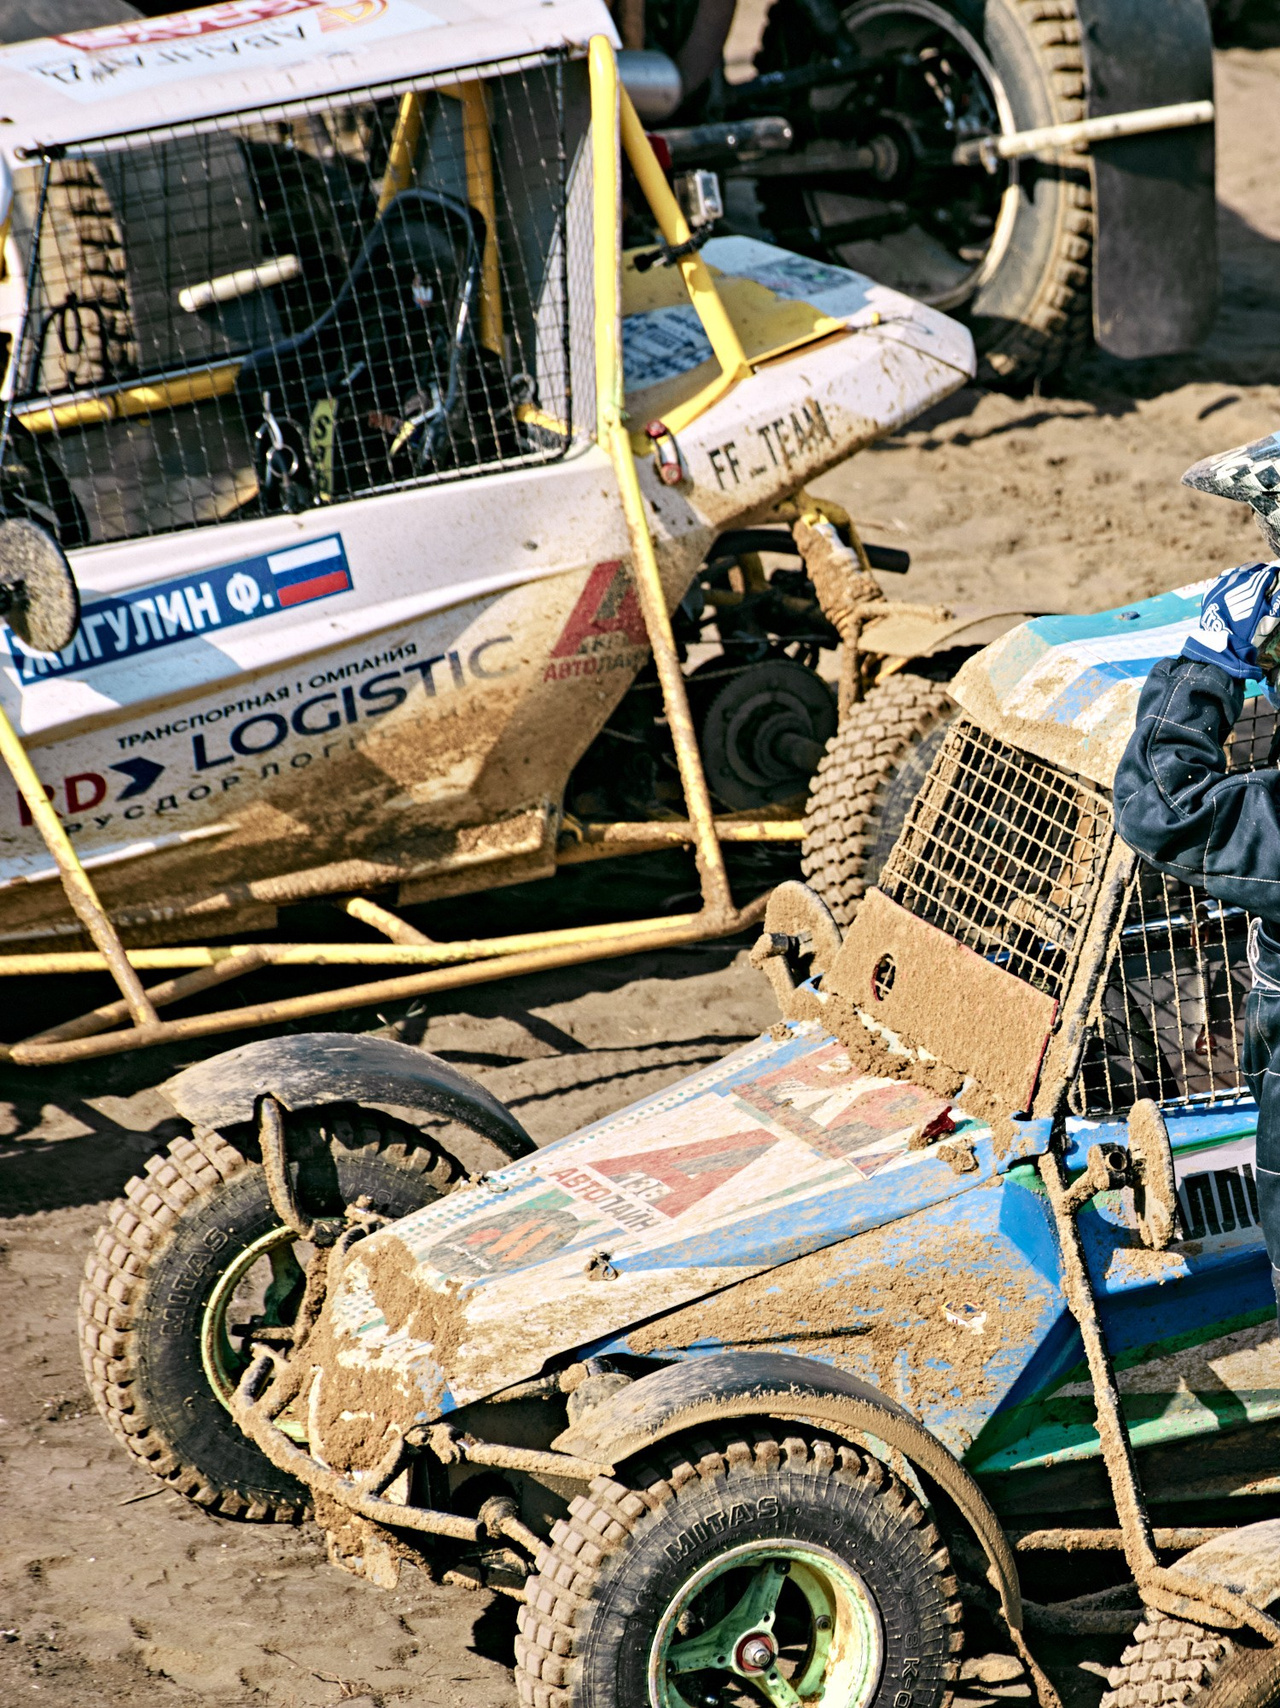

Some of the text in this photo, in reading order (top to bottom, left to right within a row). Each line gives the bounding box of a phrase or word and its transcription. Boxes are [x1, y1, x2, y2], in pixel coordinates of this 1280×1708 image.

[227, 572, 274, 615] Ф.
[117, 686, 290, 749] ТРАНСПОРТНАЯ
[548, 1167, 661, 1233] АВТОЛАЙН
[160, 1227, 229, 1337] MITAS
[664, 1495, 778, 1565] MITAS
